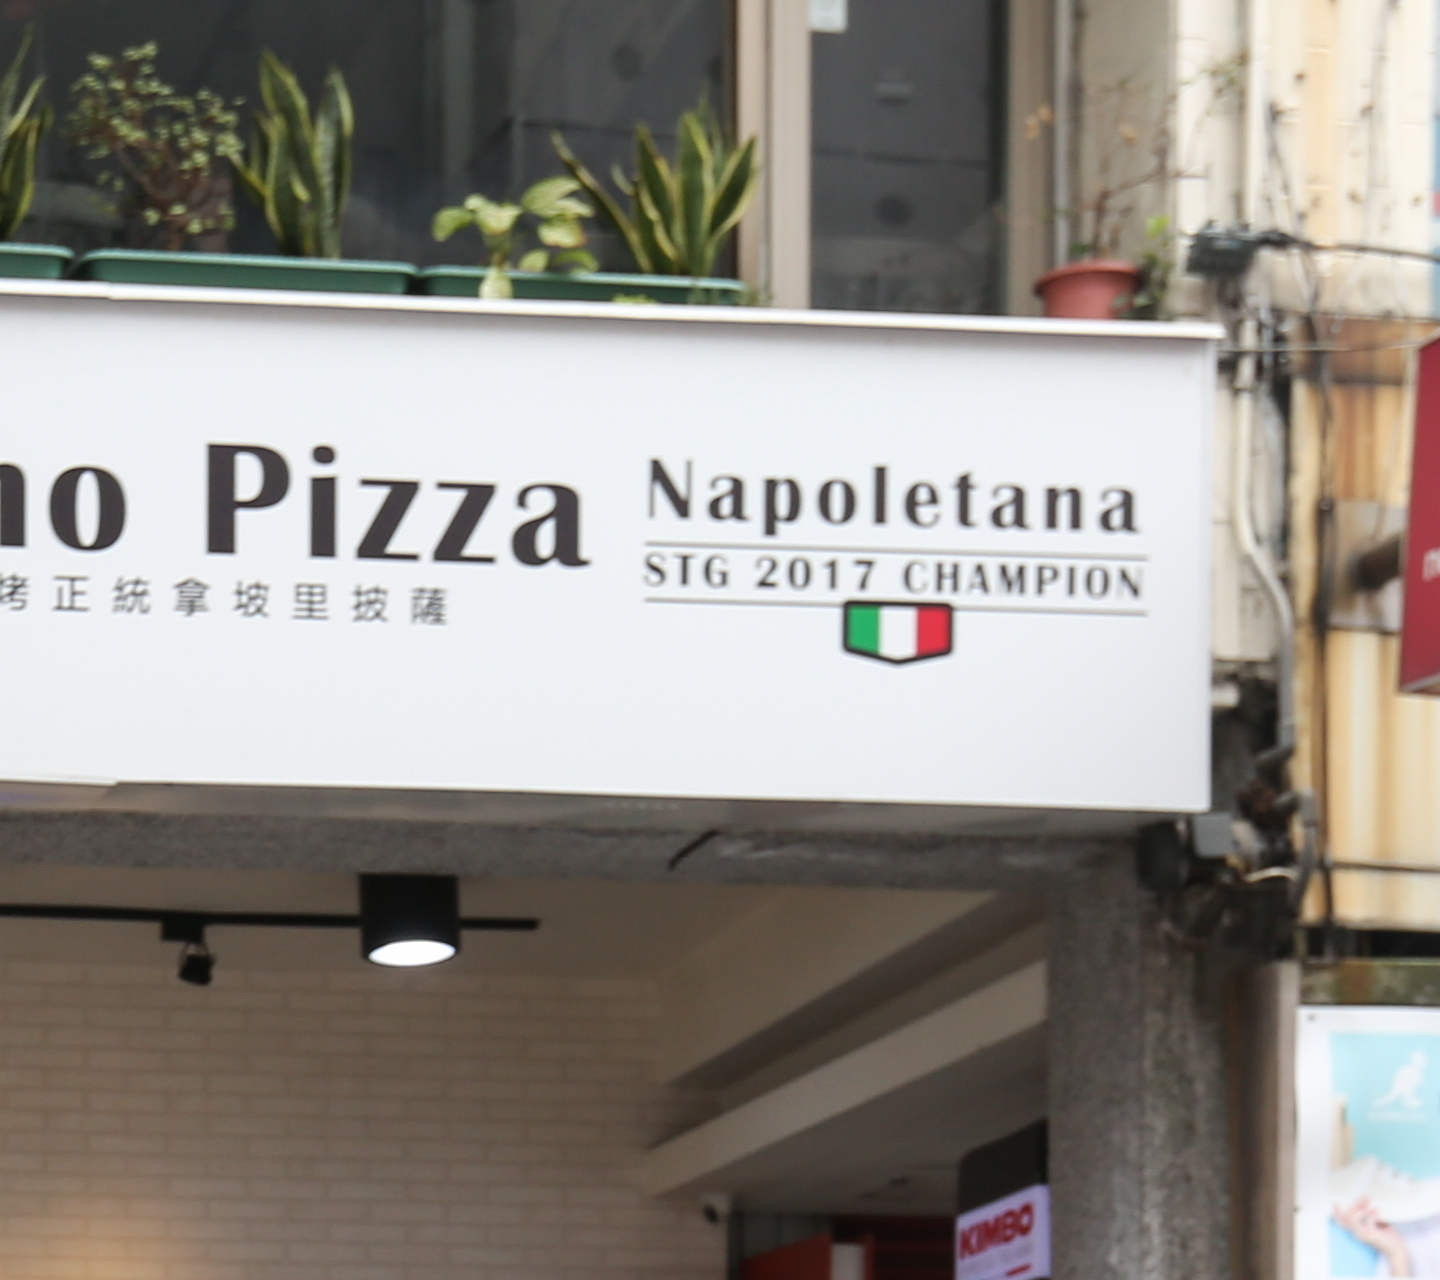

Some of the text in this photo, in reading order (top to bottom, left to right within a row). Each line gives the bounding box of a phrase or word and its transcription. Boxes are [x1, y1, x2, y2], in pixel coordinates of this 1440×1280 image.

[206, 443, 592, 567] Pizza
[647, 457, 1140, 537] Napoletana
[643, 553, 1144, 601] STG 2017 CHAMPION
